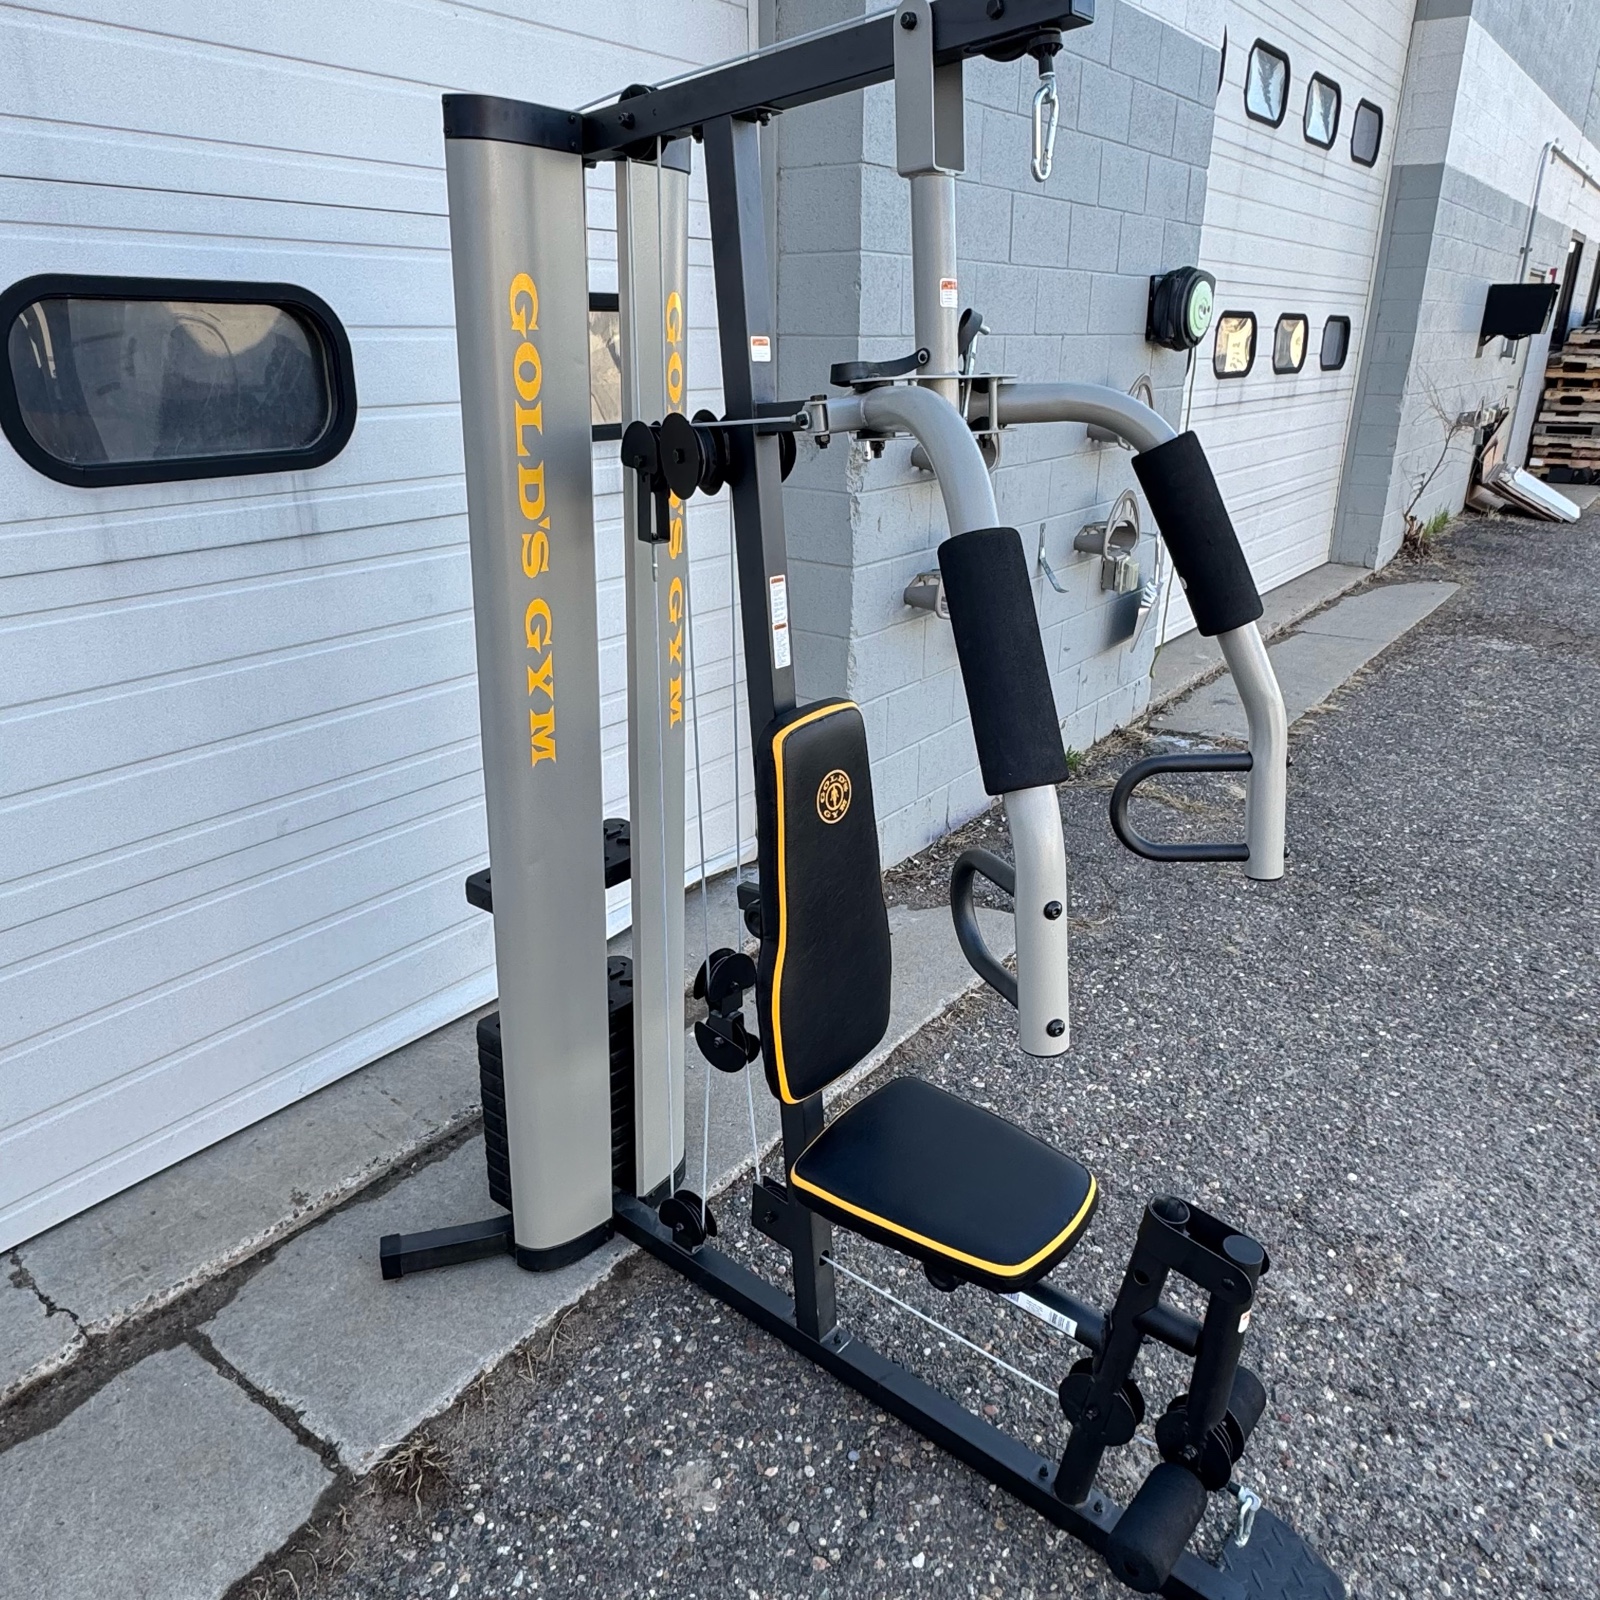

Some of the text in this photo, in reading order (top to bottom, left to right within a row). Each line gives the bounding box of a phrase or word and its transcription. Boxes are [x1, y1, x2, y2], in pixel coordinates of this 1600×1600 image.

[509, 272, 557, 768] GOLD'S GYM
[666, 291, 684, 730] GO'S GYM
[820, 774, 849, 819] GOLD'S GYM
